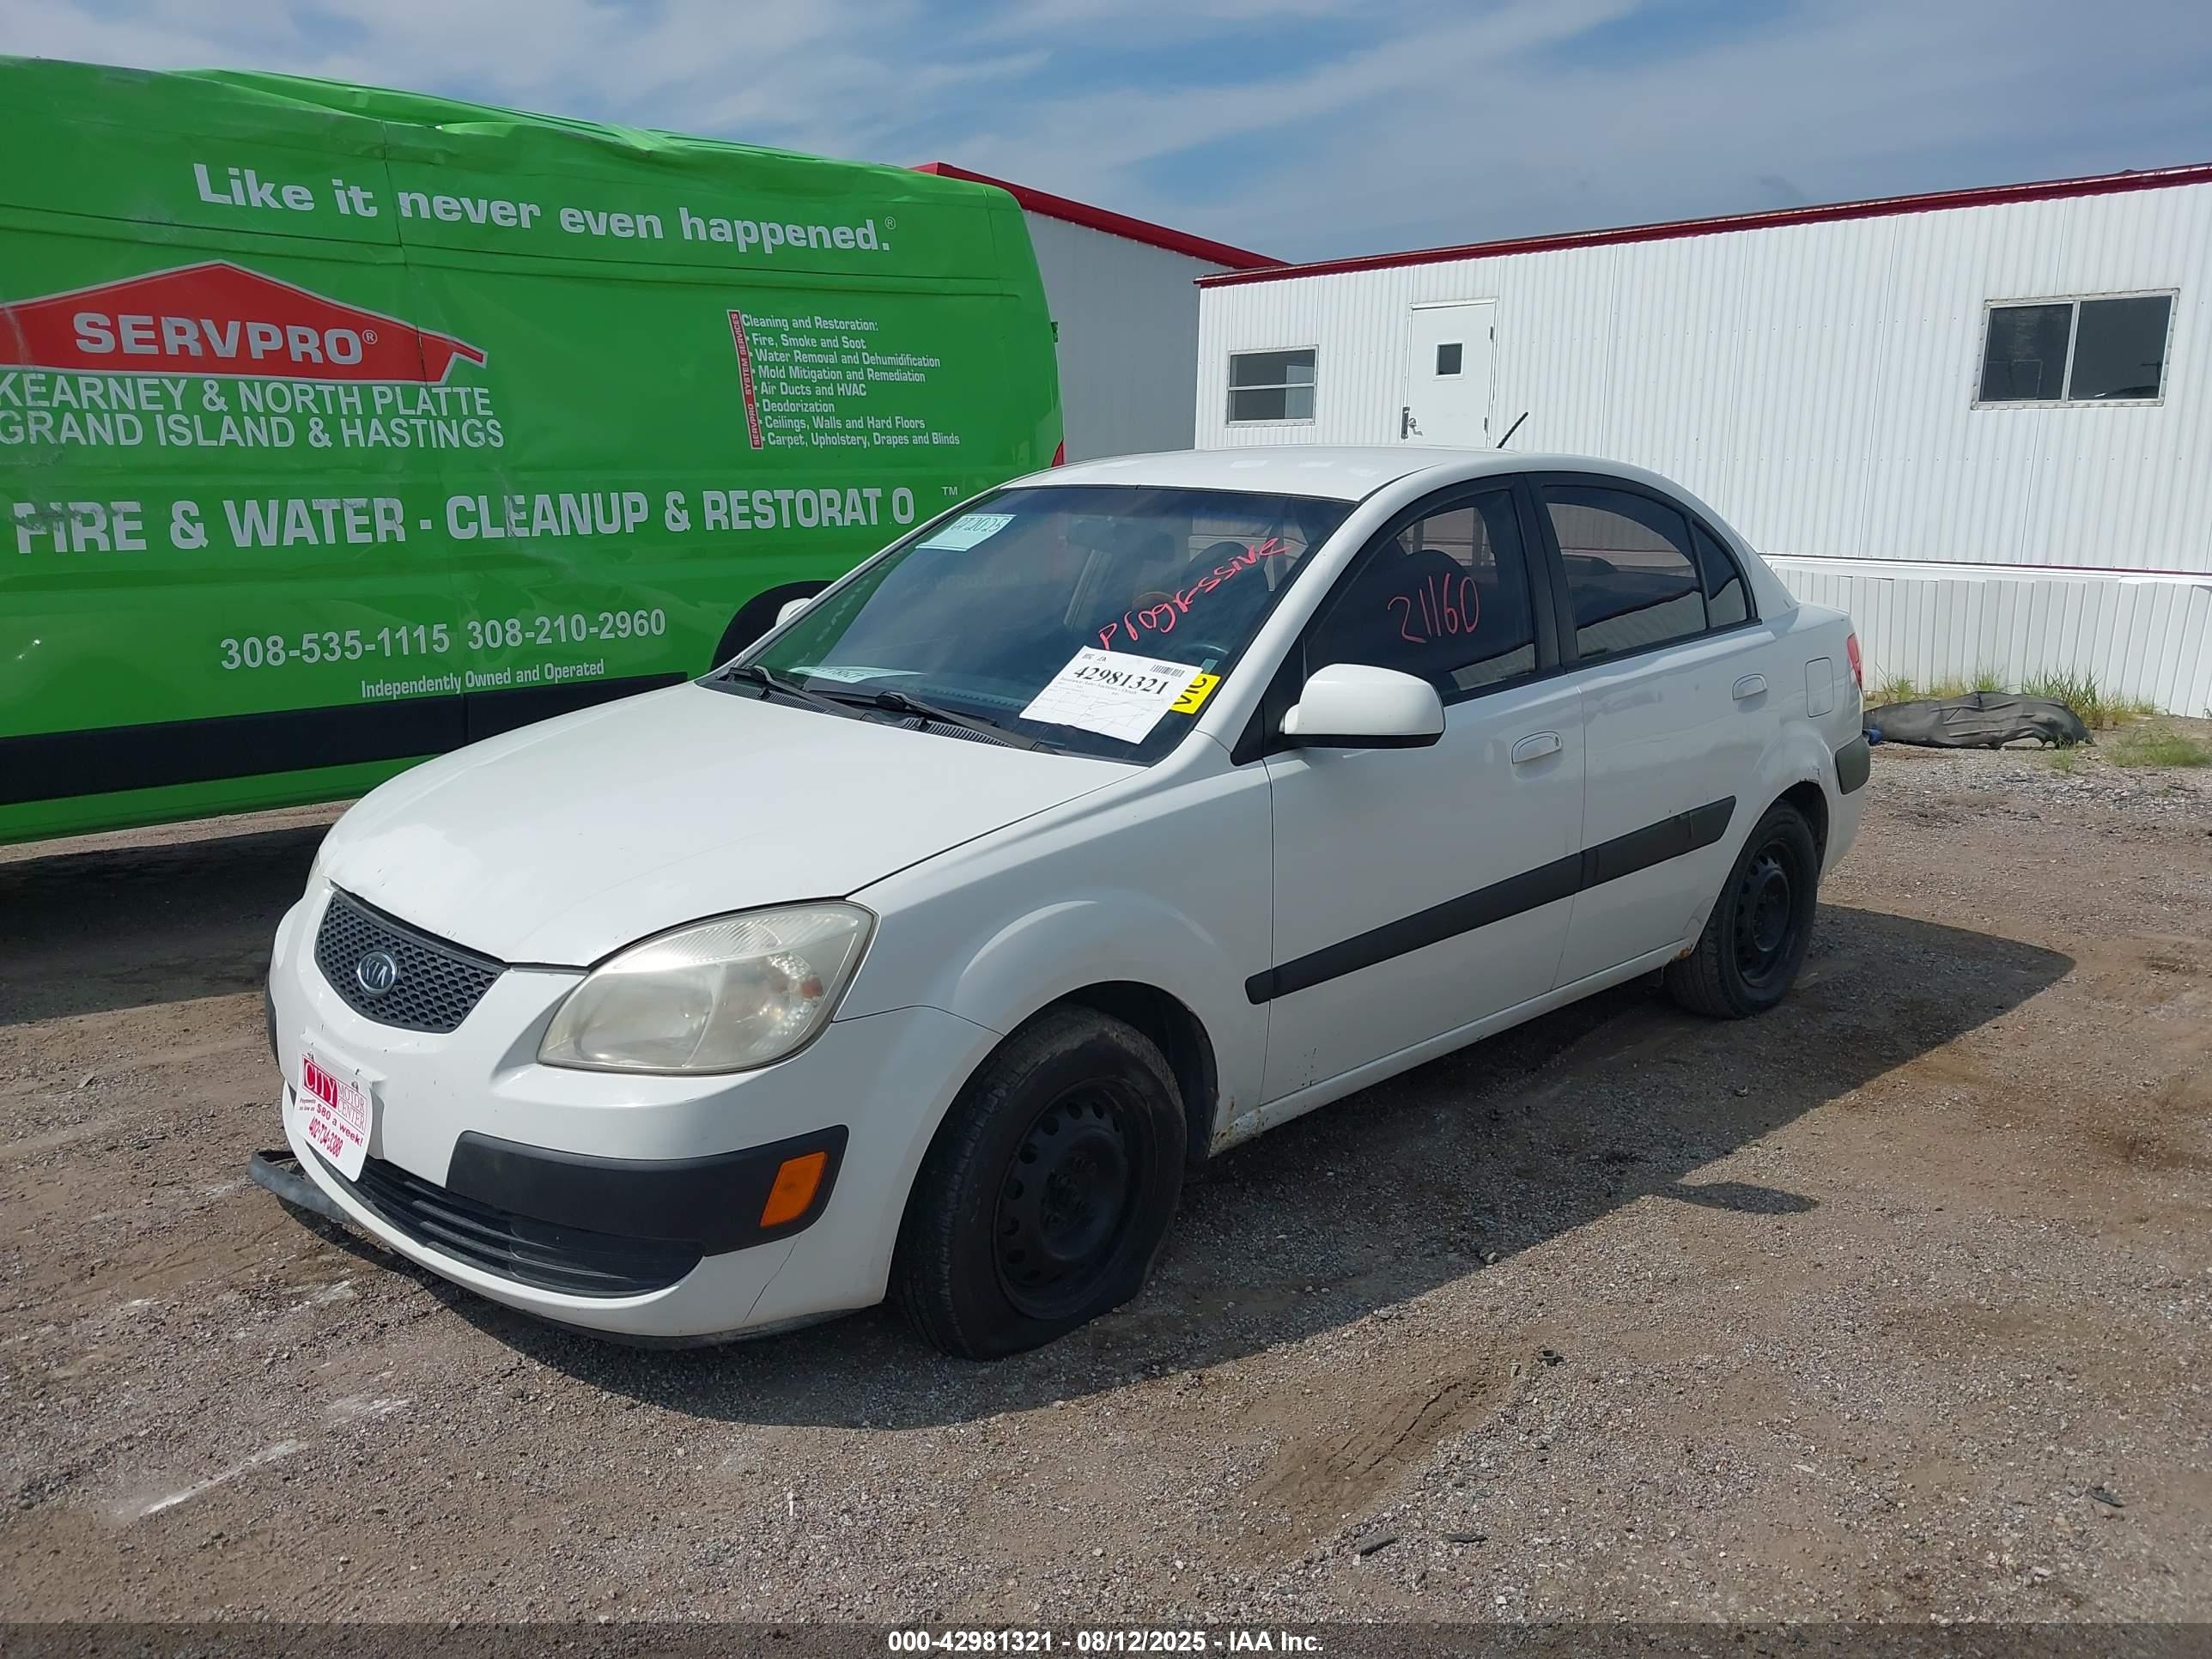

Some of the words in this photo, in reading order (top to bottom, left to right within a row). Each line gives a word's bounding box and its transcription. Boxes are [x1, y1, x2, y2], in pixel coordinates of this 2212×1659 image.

[193, 163, 315, 211] Like
[331, 179, 378, 217] it
[398, 191, 541, 229] never
[559, 205, 664, 240] even
[731, 313, 747, 356] SERVICES
[741, 313, 789, 331] Cleaning
[792, 316, 811, 328] and
[814, 315, 878, 331] Restoration:
[751, 332, 778, 348] Fire,
[780, 334, 817, 348] Smoke
[820, 336, 839, 349] and
[842, 336, 866, 349] Soot
[755, 348, 791, 362] Water
[793, 349, 838, 362] Removal
[841, 351, 859, 364] and
[861, 352, 941, 368] Dehumidification
[741, 358, 752, 395] SYSTEM
[758, 364, 786, 379] Mold
[788, 365, 842, 383] Mitigation
[846, 367, 865, 380] and
[866, 368, 926, 383] Remediation
[761, 381, 777, 395] Air
[780, 381, 811, 395] Ducts
[815, 383, 835, 396] and
[836, 383, 867, 396] HVAC
[0, 372, 187, 412] KEARNEY
[202, 380, 228, 412] &
[239, 381, 362, 416] NORTH
[374, 385, 494, 416] PLATTE
[762, 398, 836, 412] Deodorization
[0, 410, 143, 446] GRAND
[158, 414, 295, 447] ISLAND
[308, 416, 333, 448] &
[343, 417, 505, 448] HASTINGS
[747, 404, 760, 446] SERVPRO
[765, 415, 810, 432] Ceilings,
[812, 416, 842, 428] Walls
[845, 416, 864, 428] and
[866, 416, 892, 428] Hard
[895, 416, 926, 428] Floors
[768, 432, 809, 448] Carpet,
[811, 432, 871, 448] Upholstery,
[873, 432, 909, 448] Drapes
[912, 432, 930, 445] and
[932, 432, 961, 445] Blinds
[13, 501, 147, 554] FIRE
[170, 500, 209, 549] &
[223, 497, 406, 548] WATER
[446, 492, 648, 539] CLEANUP
[665, 490, 691, 532] &
[1387, 573, 1480, 644] 21160
[220, 623, 450, 670] 308-535-1115
[467, 608, 665, 650] 308-210-2960
[362, 672, 462, 699] Independently
[465, 666, 511, 689] Owned
[516, 664, 540, 684] and
[544, 658, 605, 684] Operated
[1073, 665, 1170, 695] 42981321
[305, 1061, 337, 1106] CITY
[337, 1081, 365, 1114] MOTOR
[337, 1098, 365, 1133] CENTER
[339, 1121, 363, 1148] week!
